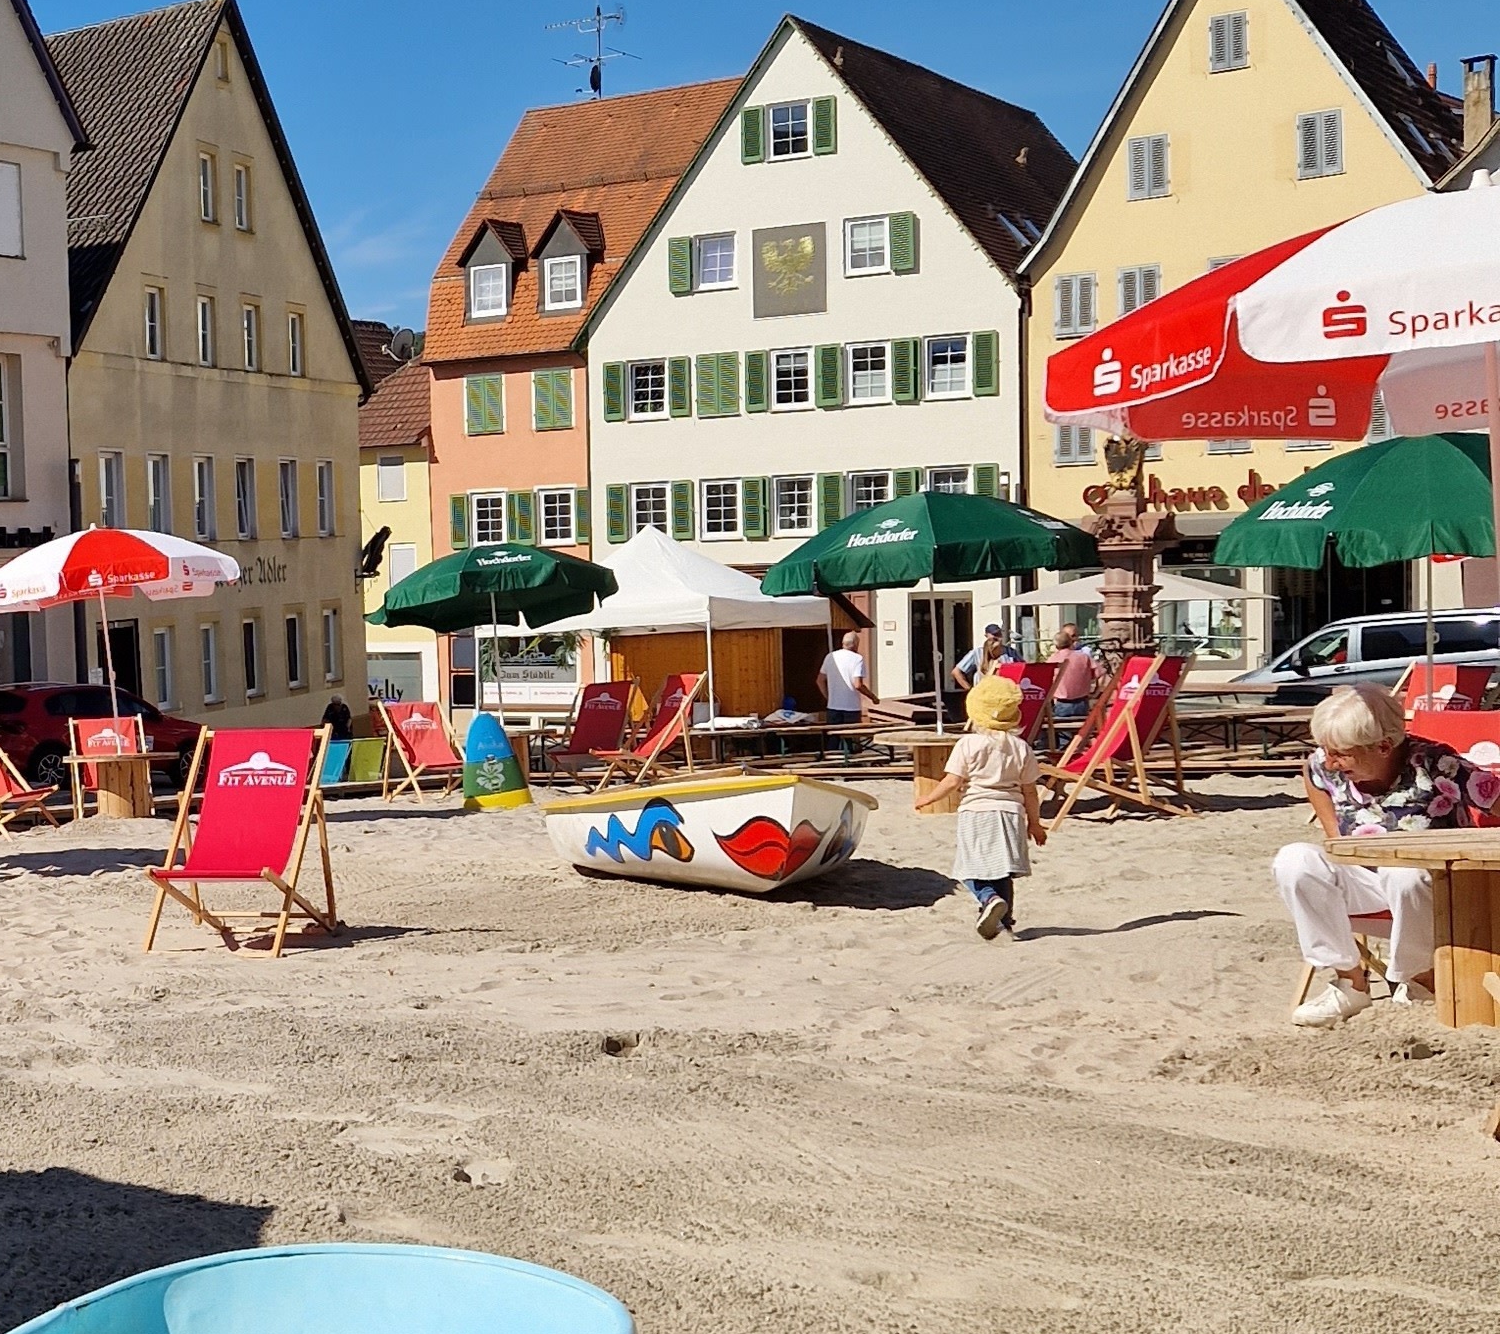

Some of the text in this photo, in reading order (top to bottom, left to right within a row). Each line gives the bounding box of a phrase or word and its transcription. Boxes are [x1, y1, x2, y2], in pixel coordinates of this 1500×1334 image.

[1130, 344, 1212, 392] Sparkasse
[1257, 500, 1334, 520] Hochdorfer
[847, 528, 919, 548] Hochdorfer
[255, 556, 288, 584] Adler
[475, 553, 533, 567] Hochdorfer
[107, 571, 156, 584] Sparkasse
[217, 772, 297, 786] FIT AVENUE
